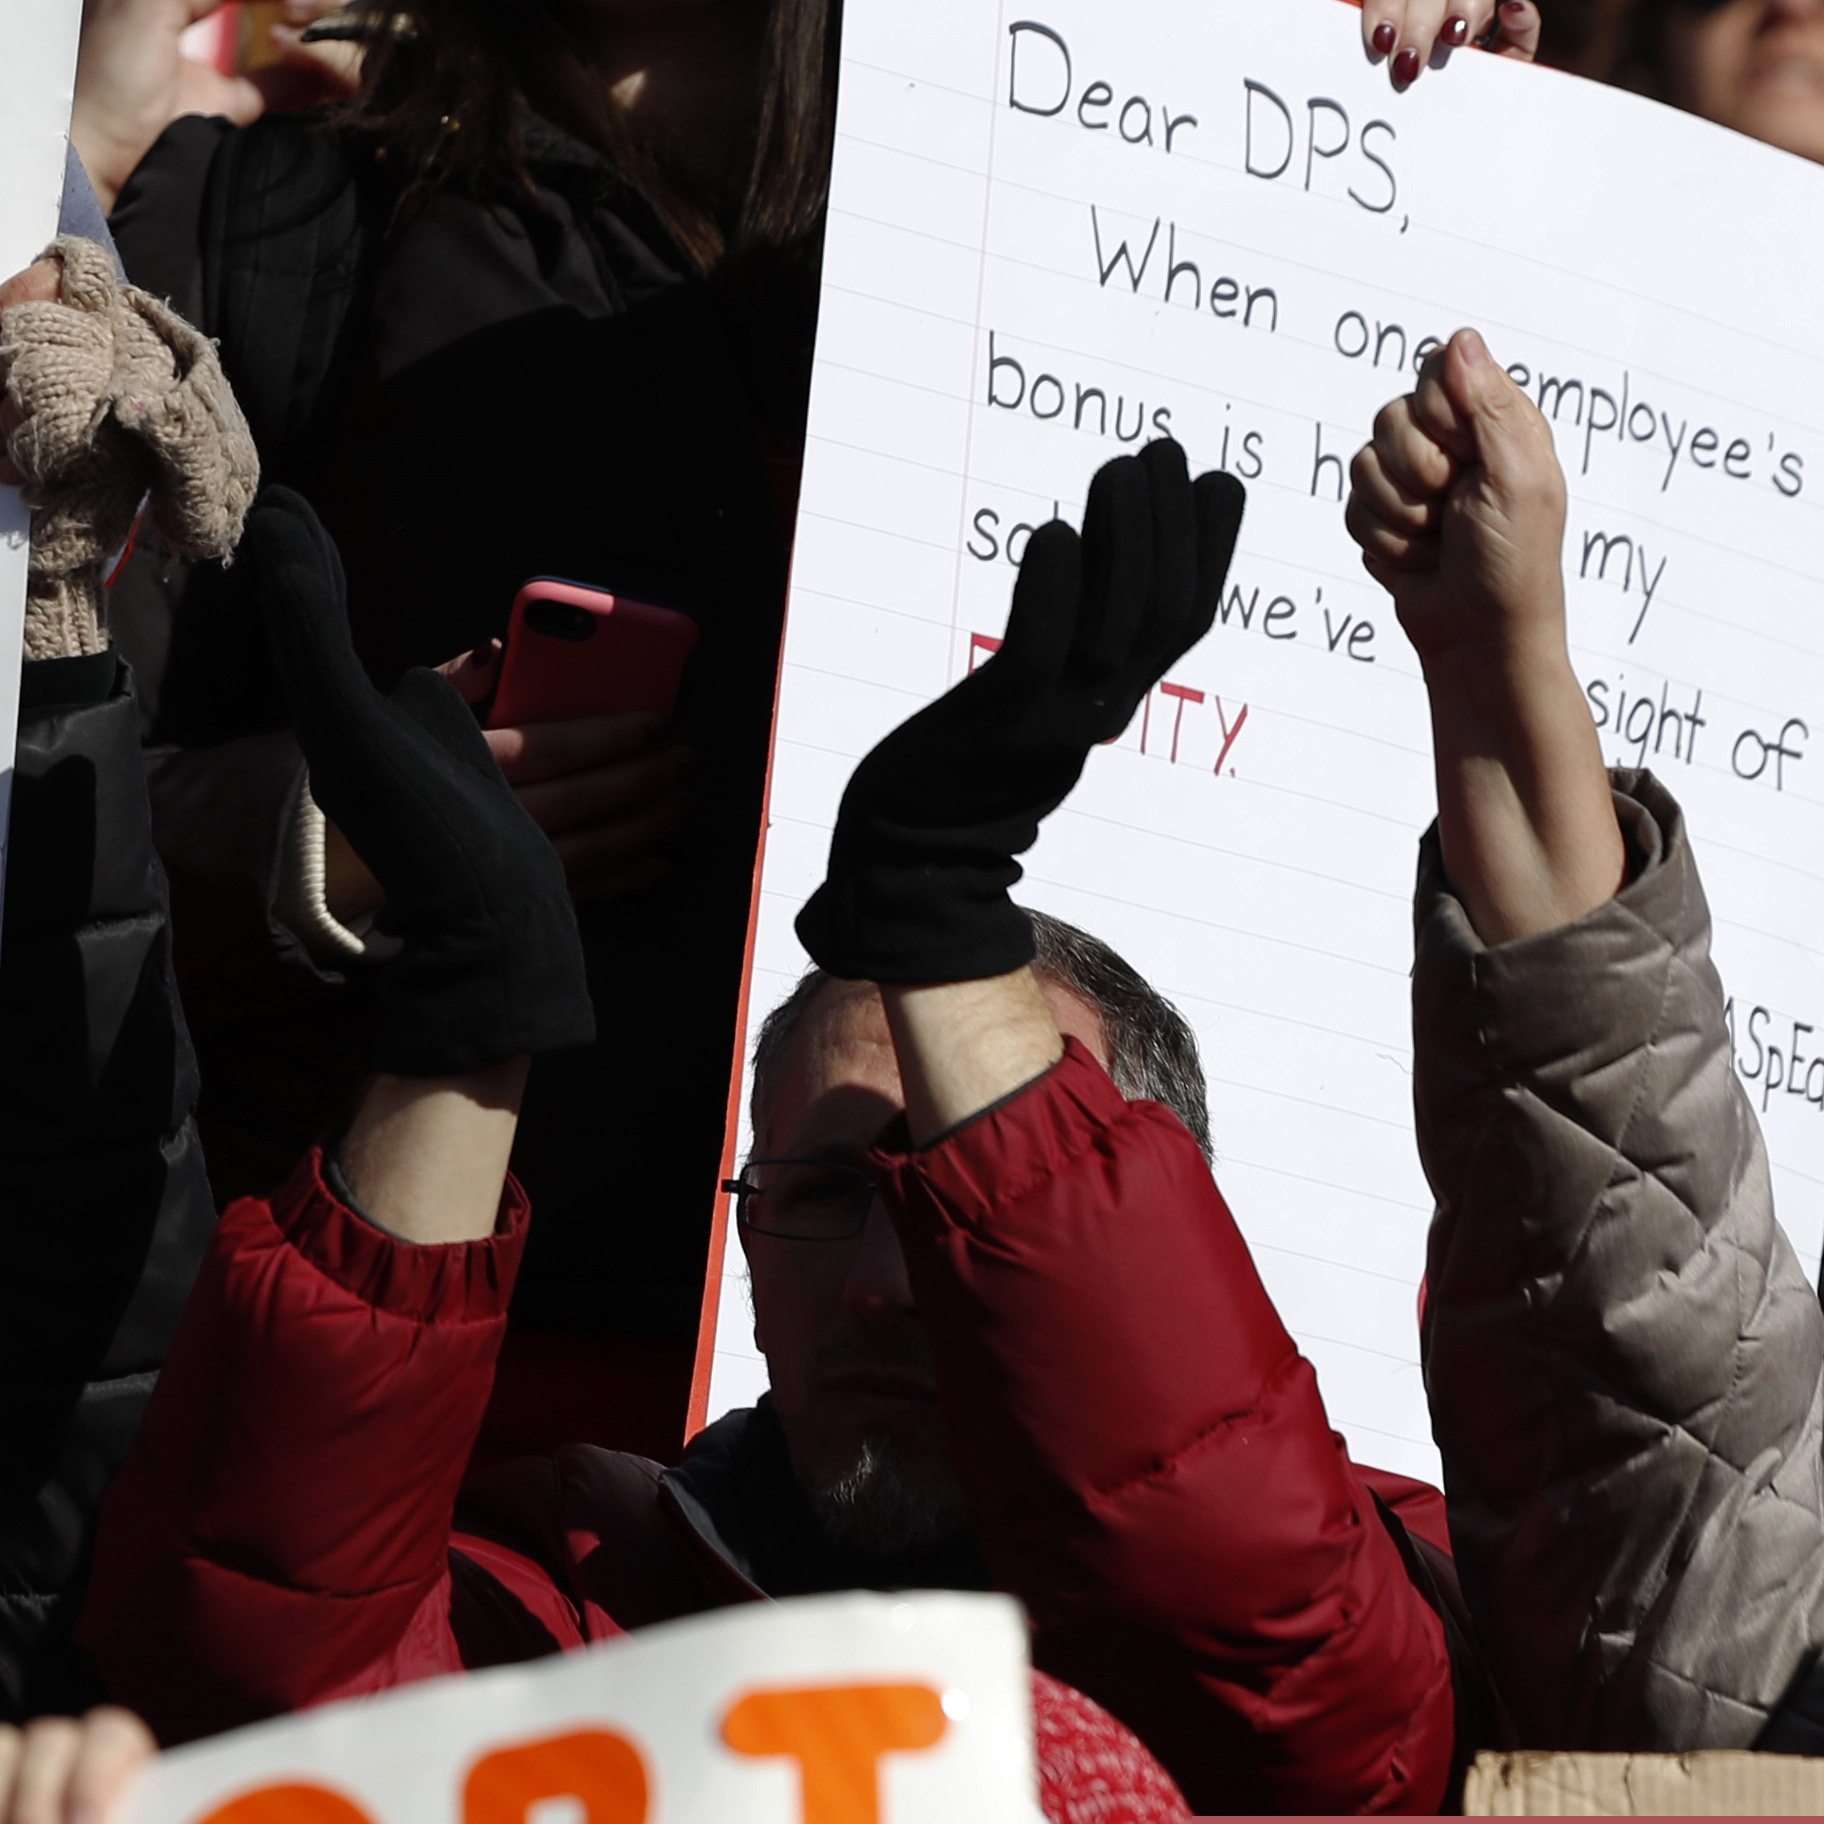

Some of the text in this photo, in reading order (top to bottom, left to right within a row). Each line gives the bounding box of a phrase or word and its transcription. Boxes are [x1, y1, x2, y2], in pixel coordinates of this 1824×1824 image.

[1007, 20, 1411, 235] Dear DPS,
[1089, 204, 1279, 333] When
[987, 329, 1175, 449] bonus
[1219, 404, 1265, 481] is
[1579, 528, 1668, 646] my
[1217, 582, 1811, 792] we've sight of
